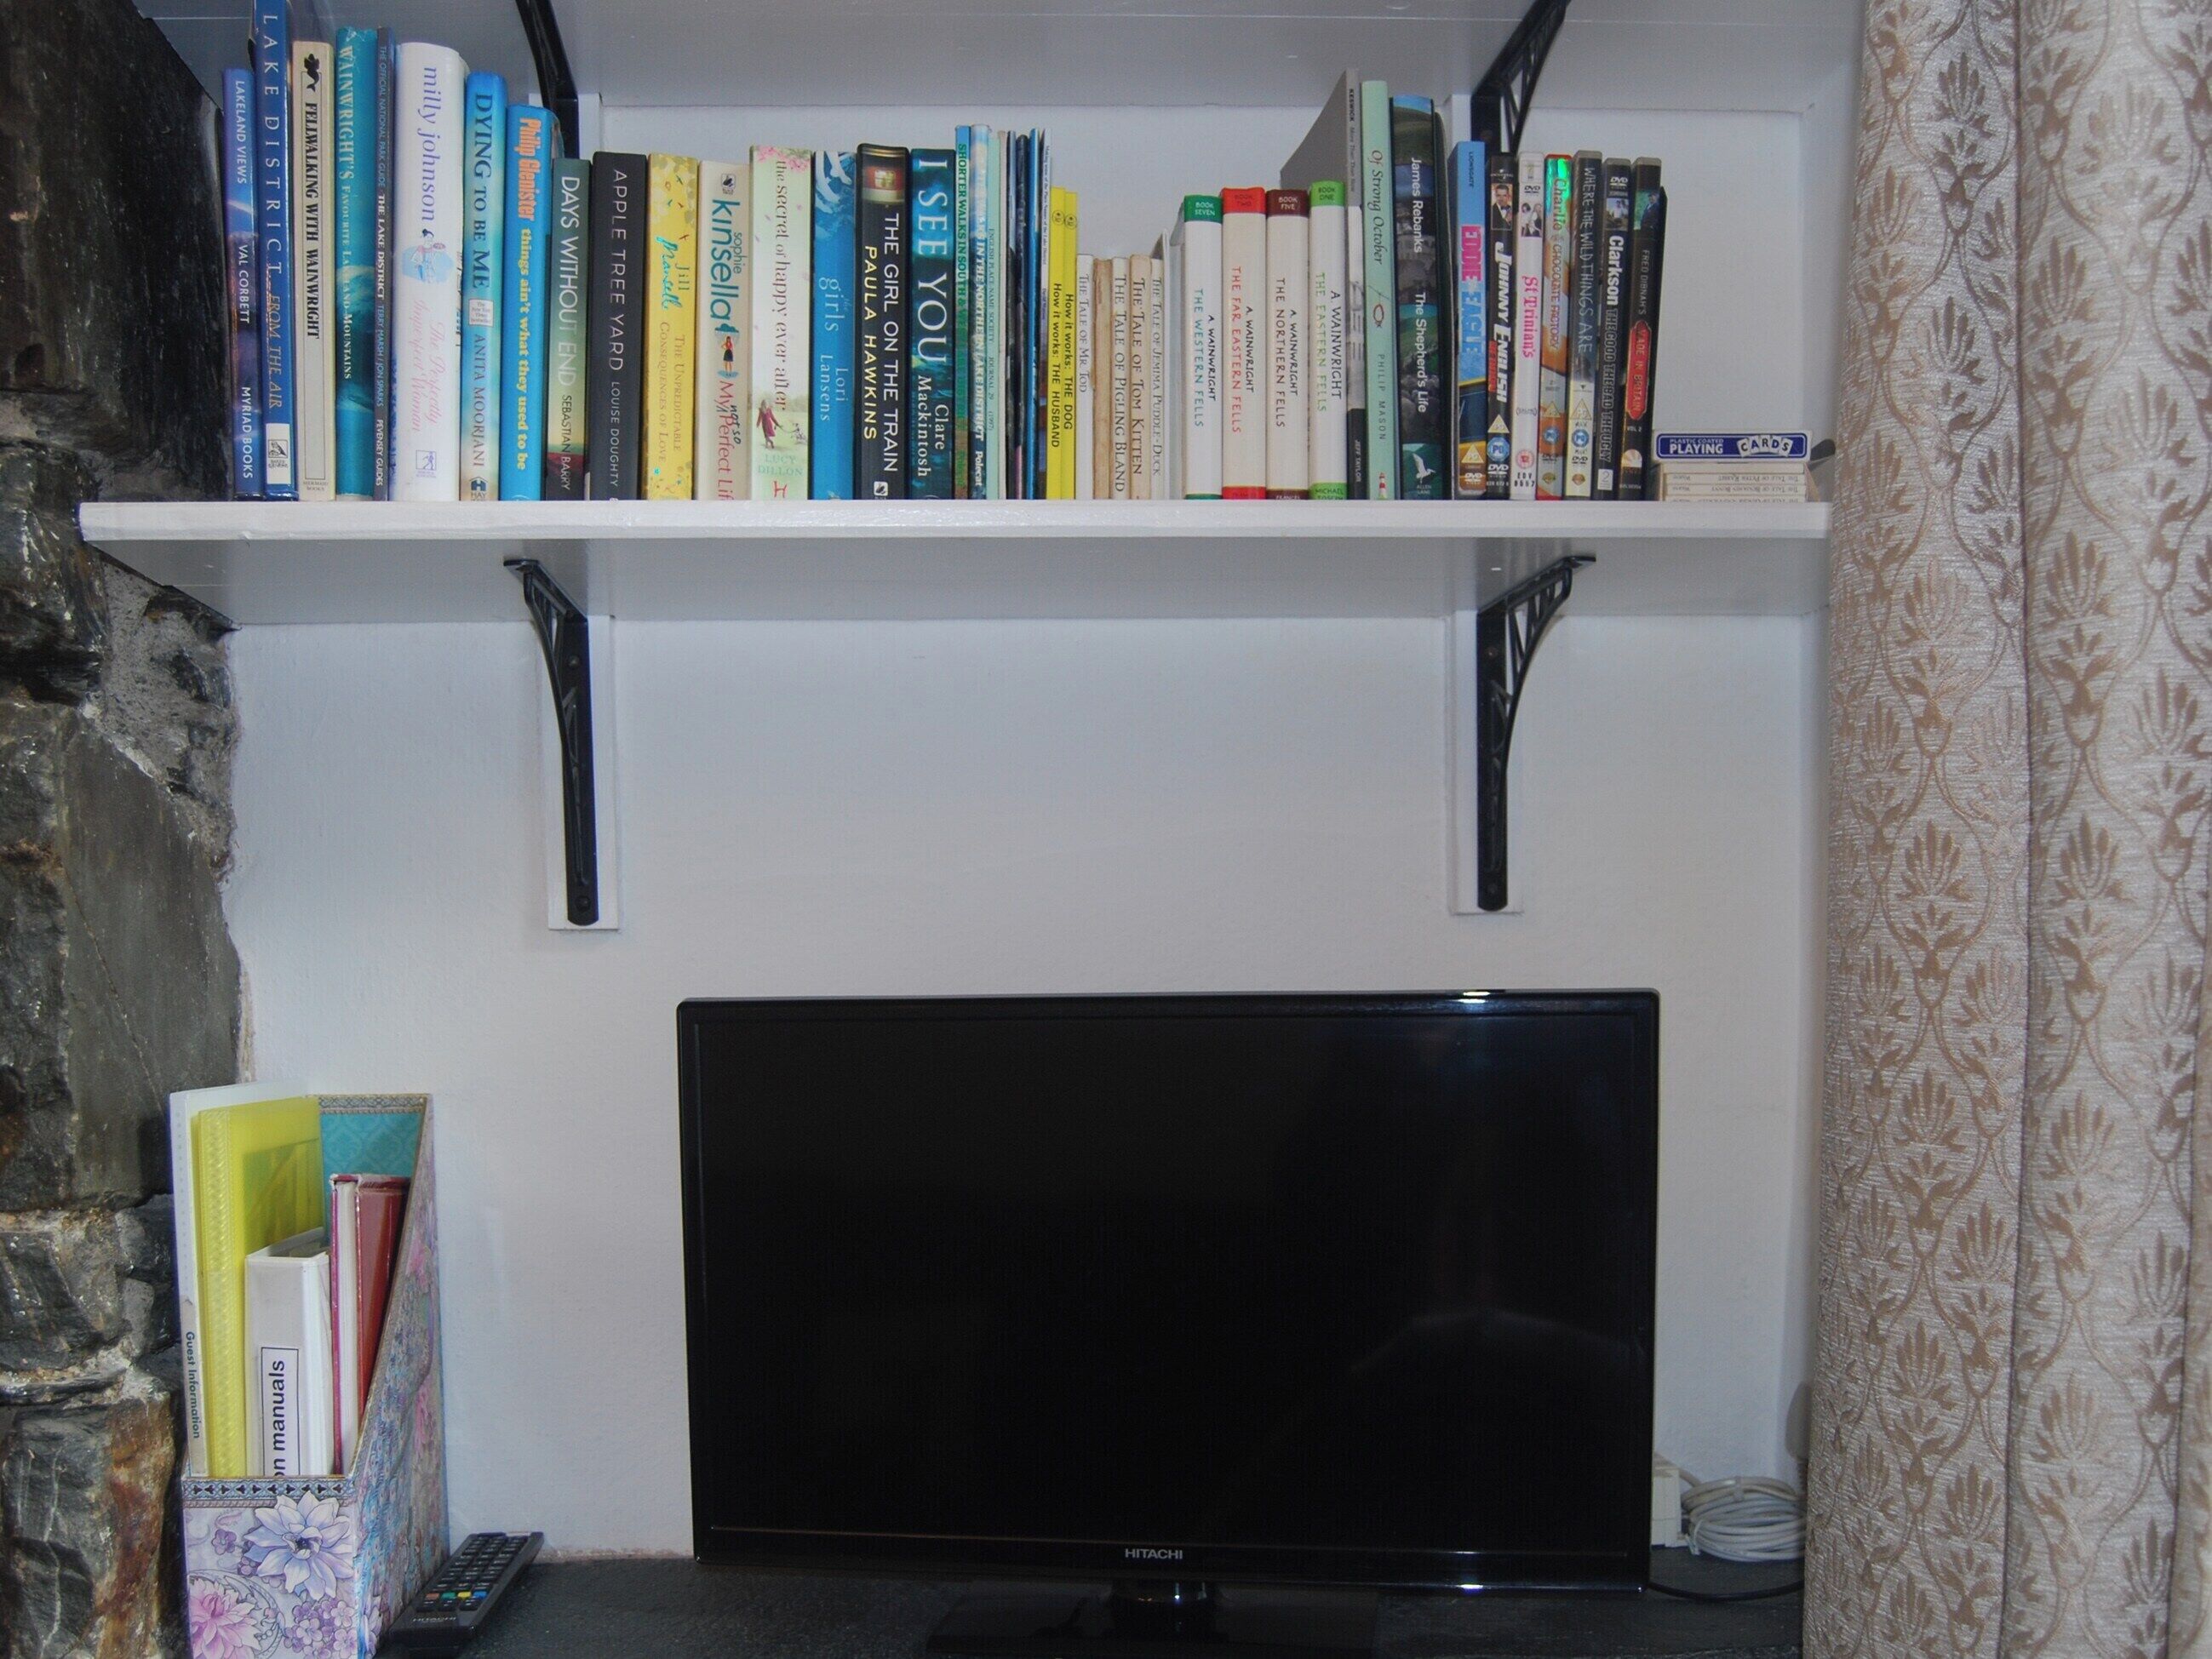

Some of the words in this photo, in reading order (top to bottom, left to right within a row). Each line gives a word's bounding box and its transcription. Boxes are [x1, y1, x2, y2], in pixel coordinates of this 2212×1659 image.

[263, 15, 278, 94] LAKE
[235, 80, 246, 142] LAKELAND
[340, 45, 354, 179] WAINWRIGHT'S
[418, 66, 441, 124] milly
[306, 103, 318, 197] FELLWALKING
[474, 94, 493, 179] DYING
[515, 118, 541, 157] Philip
[1368, 150, 1384, 166] Of
[237, 146, 246, 184] VIEWS
[417, 128, 440, 221] johnson
[776, 161, 786, 181] the
[918, 159, 948, 169] I
[1412, 157, 1422, 197] James
[265, 116, 281, 274] DISTRICT
[473, 187, 487, 213] TO
[519, 159, 541, 221] Glenister
[560, 176, 580, 228] DAYS
[611, 169, 627, 240] APPLE
[1367, 169, 1384, 212] Strong
[1582, 167, 1596, 206] WHERE
[306, 203, 318, 242] WITH
[342, 185, 351, 246] FAVOURITE
[473, 220, 486, 241] BE
[776, 186, 788, 238] secret
[918, 190, 948, 255] SEE
[1413, 199, 1423, 254] Rebanks
[1582, 209, 1593, 228] THE
[238, 243, 249, 266] VAL
[518, 229, 530, 277] things
[733, 231, 748, 274] sophie
[884, 213, 899, 255] THE
[1372, 216, 1388, 266] October
[1580, 232, 1593, 260] WILD
[473, 250, 490, 289] ME
[610, 249, 626, 305] TREE
[675, 263, 690, 291] Jill
[710, 198, 741, 321] kinsella
[1232, 266, 1241, 291] THE
[1607, 236, 1624, 306] Clarkson
[239, 271, 249, 323] CORBETT
[306, 249, 320, 339] WAINWRIGHT
[519, 281, 531, 313] ain't
[559, 236, 579, 331] WITHOUT
[772, 260, 791, 317] happy
[863, 245, 877, 321] PAULA
[884, 263, 899, 312] GIRL
[1053, 283, 1062, 308] How
[1115, 274, 1126, 305] THE
[1133, 278, 1145, 306] THE
[1195, 289, 1203, 313] THE
[1276, 278, 1285, 302] THE
[1495, 241, 1513, 323] JOHNNY
[1522, 277, 1539, 294] St
[1579, 264, 1593, 317] THINGS
[269, 294, 281, 338] FROM
[818, 277, 845, 331] girls
[918, 273, 948, 363] YOU
[1065, 294, 1074, 319] How
[1232, 298, 1241, 322] FAR
[1415, 292, 1426, 316] The
[343, 313, 352, 379] MOUNTAINS
[519, 317, 530, 356] what
[609, 313, 624, 371] YARD
[674, 335, 685, 358] THE
[775, 321, 787, 363] ever
[884, 321, 898, 352] ON
[1052, 322, 1062, 358] works:
[1115, 311, 1126, 346] TALE
[1132, 312, 1145, 347] TALE
[1276, 310, 1285, 384] NORTHERN
[1522, 298, 1539, 359] Trinian's
[1579, 323, 1593, 354] ARE
[269, 345, 281, 377] THE
[473, 334, 485, 380] ANITA
[558, 342, 576, 386] END
[657, 321, 670, 410] CONSEQUENCES
[1064, 333, 1074, 369] works:
[1115, 352, 1125, 372] OF
[1132, 354, 1142, 373] OF
[1195, 320, 1203, 383] WESTERN
[1232, 329, 1241, 390] EASTERN
[1246, 321, 1254, 392] WAINWRIGHT
[1331, 306, 1342, 399] WAINWRIGHT
[1376, 353, 1385, 392] PHILIP
[1415, 318, 1427, 387] Shepherd's
[1494, 323, 1512, 403] ENGLISH
[269, 385, 282, 408] AIR
[517, 358, 530, 394] they
[774, 368, 789, 411] after
[820, 354, 833, 421] Lansens
[835, 366, 849, 402] Lori
[864, 335, 877, 440] HAWKINS
[884, 360, 898, 402] THE
[1064, 378, 1073, 398] THE
[1132, 380, 1143, 409] TOM
[242, 387, 251, 432] MYRIAD
[518, 397, 528, 431] used
[562, 395, 571, 453] SEBASTIAN
[610, 382, 620, 425] LOUISE
[660, 414, 665, 426] OF
[673, 363, 685, 450] UNPREDICTABLE
[1052, 392, 1060, 448] HUSBAND
[1064, 405, 1073, 430] DOG
[1115, 378, 1126, 436] PIGLING
[1195, 390, 1204, 426] FELLS
[1232, 396, 1241, 433] FELLS
[1276, 391, 1286, 427] FELLS
[1378, 400, 1387, 440] MASON
[1418, 391, 1428, 414] Life
[471, 387, 485, 466] MOORJANI
[517, 432, 527, 449] to
[659, 429, 669, 462] LOVE
[718, 415, 734, 472] Perfect
[884, 409, 898, 471] TRAIN
[918, 375, 931, 477] Mackintosh
[935, 403, 949, 449] Clare
[1132, 418, 1144, 474] KITTEN
[1670, 443, 1723, 454] PLAYING
[1740, 438, 1790, 451] CARDS
[242, 438, 253, 478] BOOKS
[517, 453, 528, 470] be
[561, 456, 570, 490] BARRY
[610, 428, 619, 487] DOUGHTY
[1115, 442, 1126, 492] BLAND
[718, 480, 734, 500] Lif
[186, 1331, 195, 1365] Guest
[188, 1370, 199, 1439] Information
[269, 1360, 285, 1451] manuals
[1125, 1548, 1183, 1559] HITACHI
